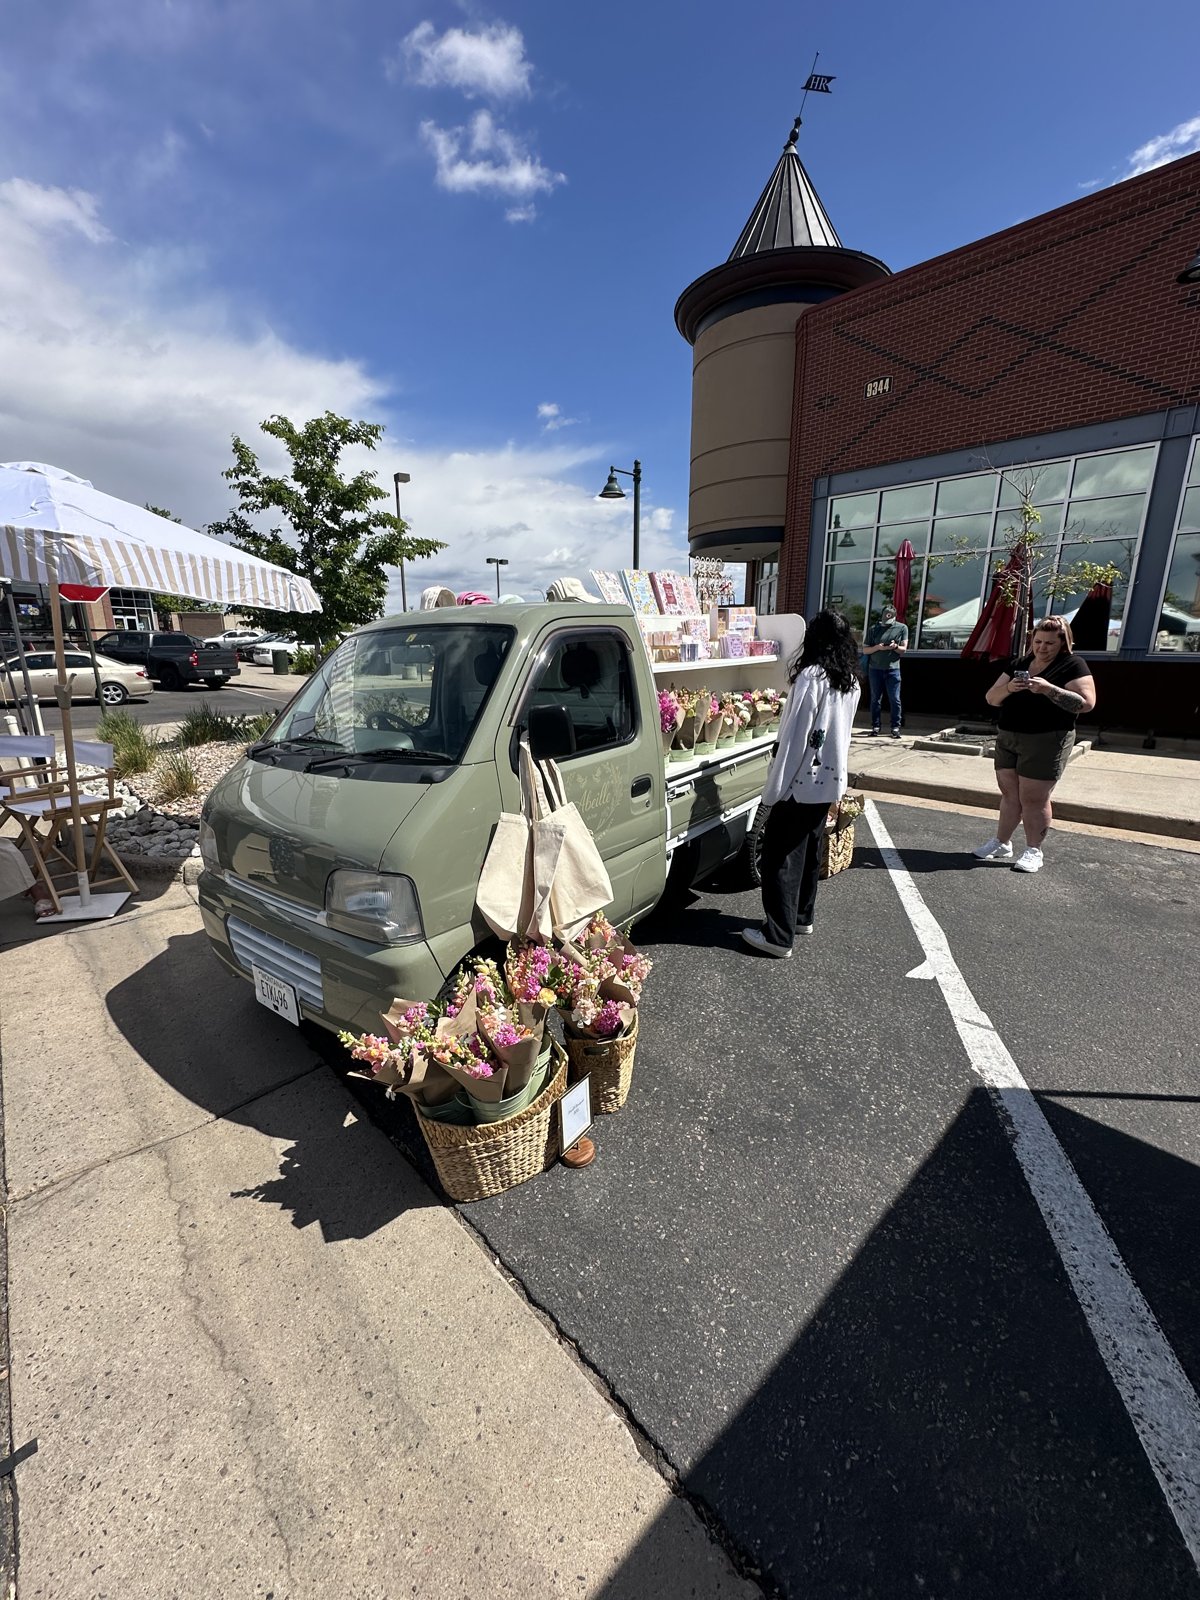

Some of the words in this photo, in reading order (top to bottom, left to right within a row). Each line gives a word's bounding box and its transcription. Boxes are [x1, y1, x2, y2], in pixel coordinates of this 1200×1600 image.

[810, 76, 828, 91] HR
[866, 378, 890, 397] 9344
[574, 782, 611, 813] Abeille
